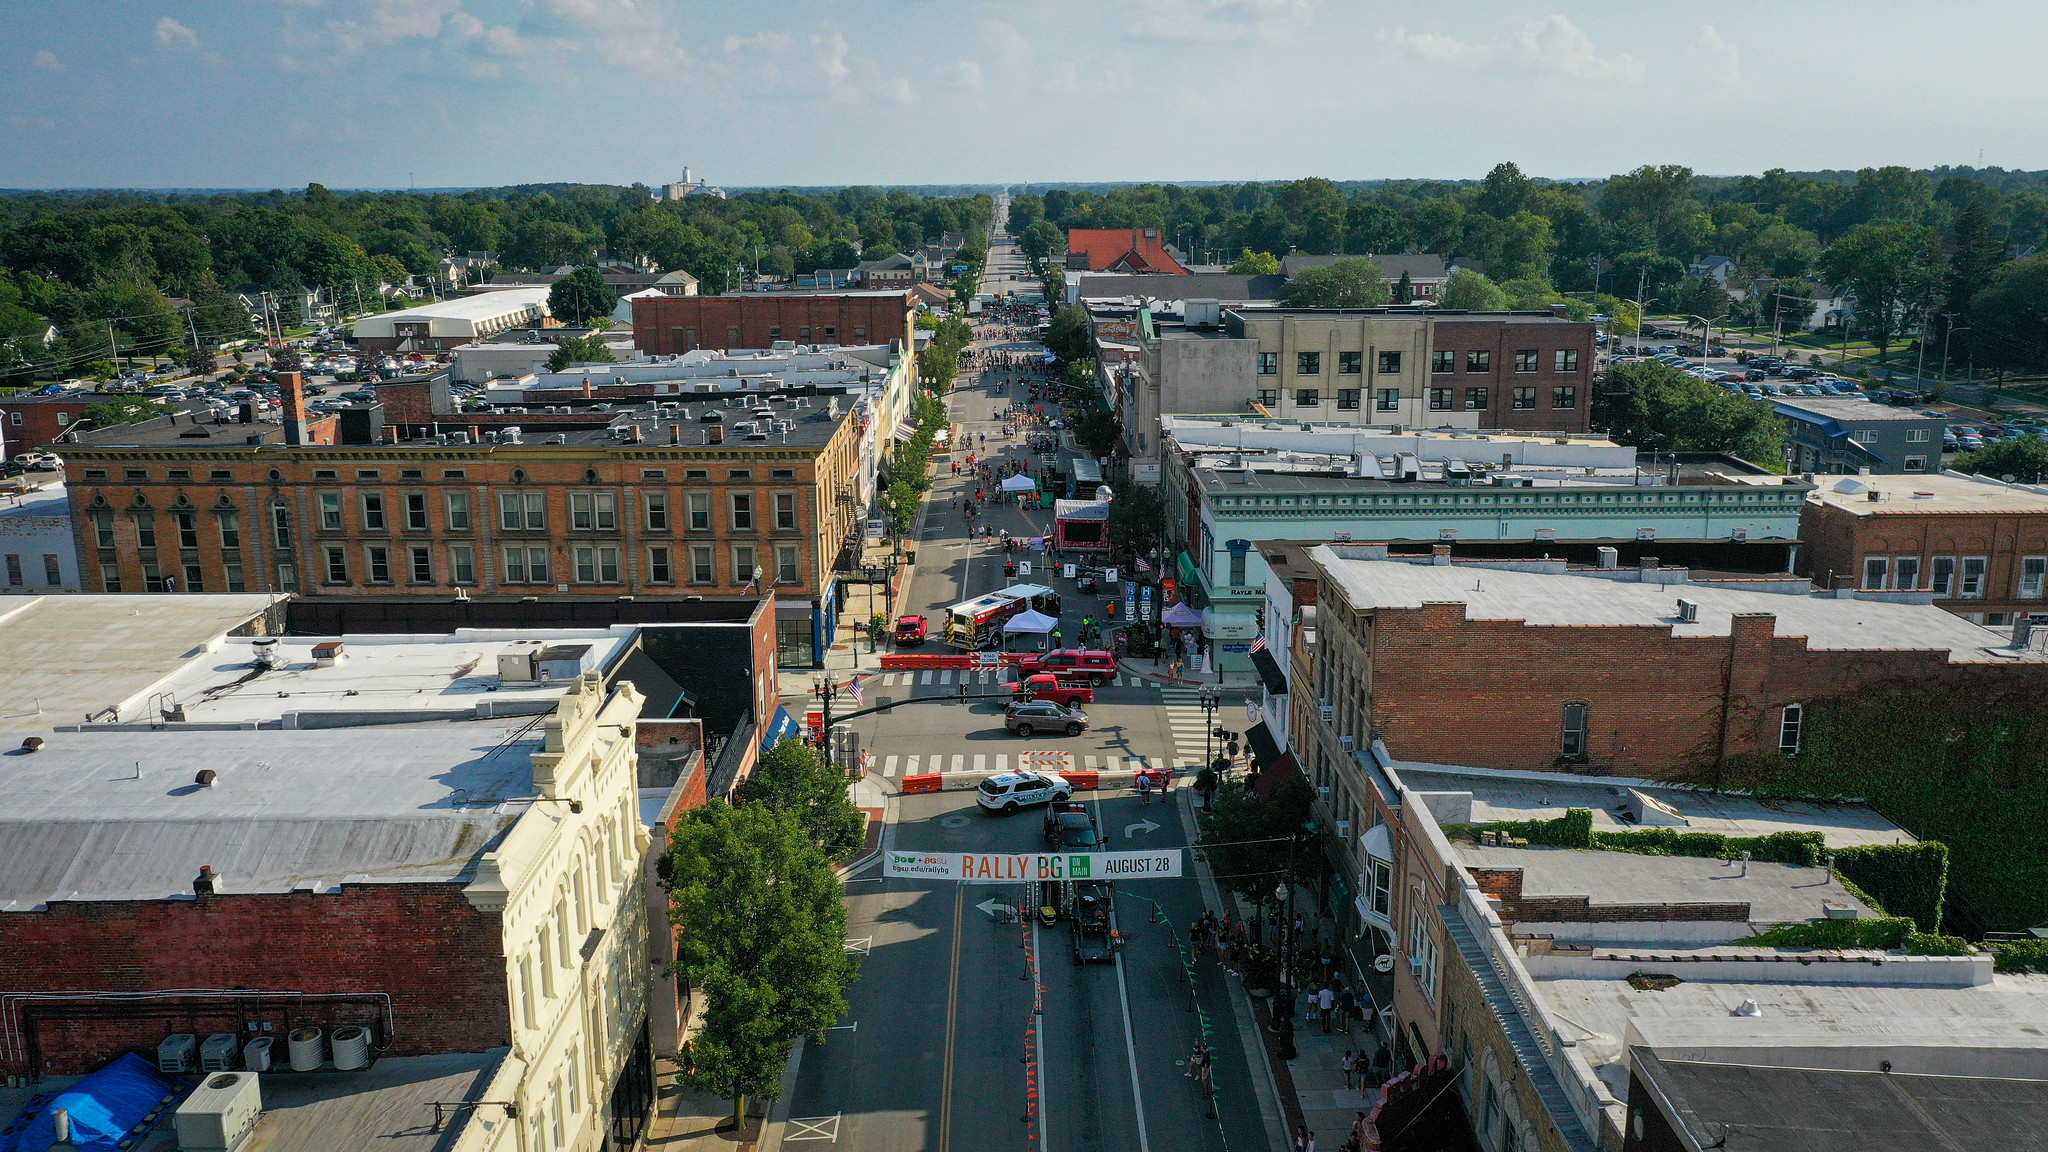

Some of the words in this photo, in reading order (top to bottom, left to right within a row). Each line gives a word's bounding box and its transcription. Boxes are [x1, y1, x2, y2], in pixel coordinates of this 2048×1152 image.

[1072, 857, 1080, 866] ON
[1105, 858, 1151, 874] AUGUST
[1155, 857, 1170, 872] 28
[892, 864, 949, 874] bgsu.edu/rallybg
[962, 855, 1029, 878] RALLY
[1037, 855, 1063, 879] BG
[1072, 867, 1088, 876] MAIN
